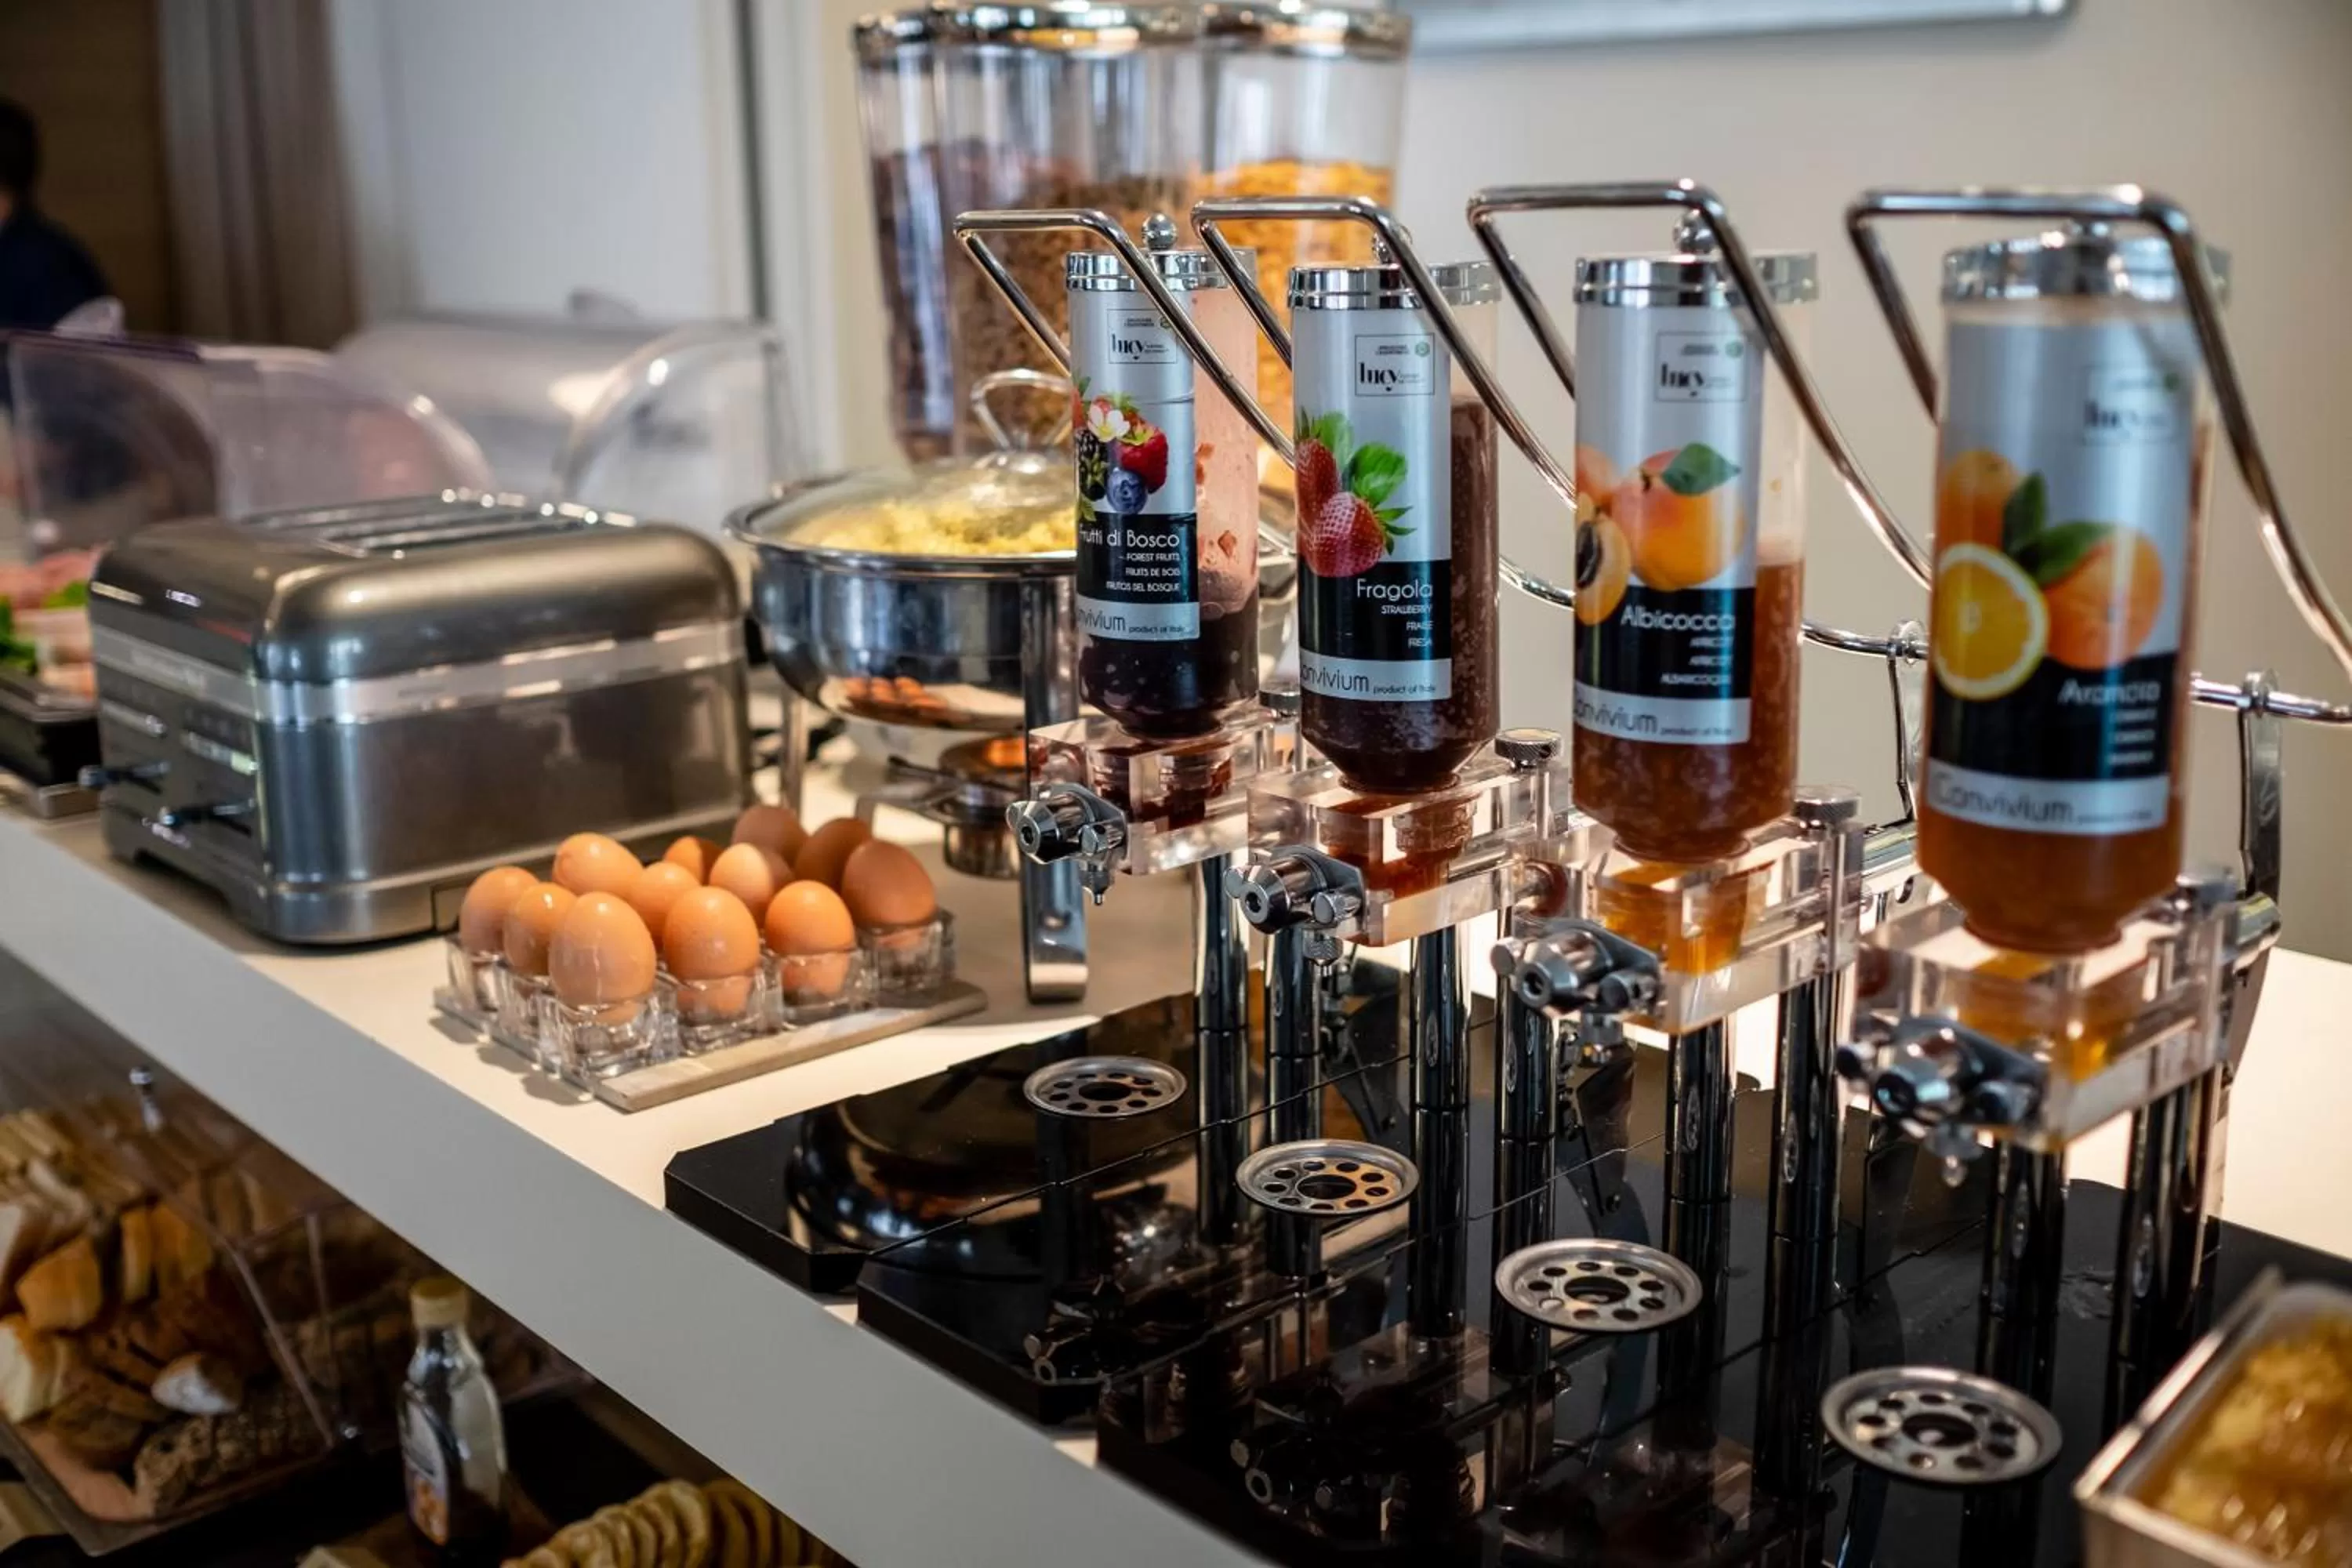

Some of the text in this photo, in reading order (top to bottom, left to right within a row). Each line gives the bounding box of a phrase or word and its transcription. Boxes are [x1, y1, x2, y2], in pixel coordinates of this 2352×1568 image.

[1360, 362, 1397, 392] lucy
[1106, 528, 1121, 547] di
[1127, 529, 1180, 548] Bosco
[1357, 579, 1433, 602] Fragola
[1077, 608, 1126, 631] nvivium
[1620, 604, 1737, 632] Albicocca
[1301, 664, 1369, 692] onvivium
[1574, 699, 1659, 735] onvivium
